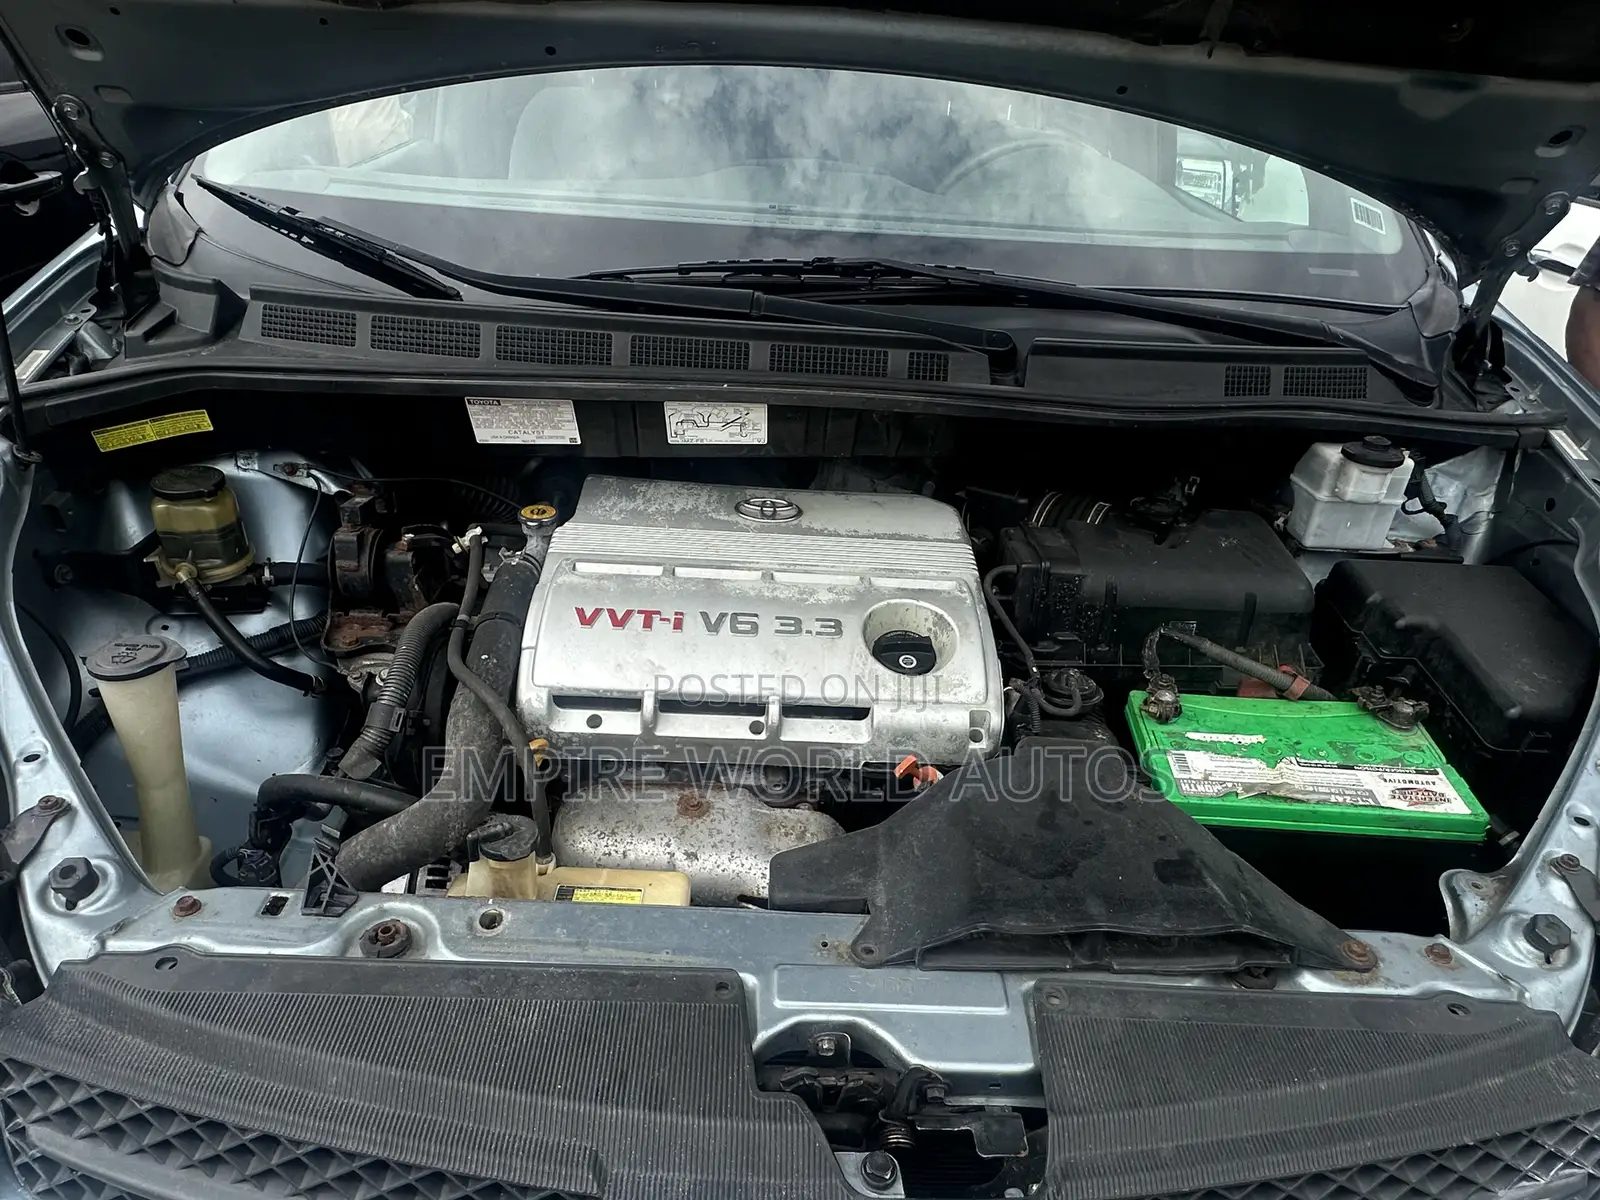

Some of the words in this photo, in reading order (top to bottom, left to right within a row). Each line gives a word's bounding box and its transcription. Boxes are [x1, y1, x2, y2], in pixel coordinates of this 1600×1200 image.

[574, 606, 685, 633] VVT-i
[699, 610, 760, 637] V6
[774, 615, 843, 639] 3.3
[1382, 777, 1436, 786] AUTOMOTIVE
[1387, 793, 1452, 804] INTERSTATE
